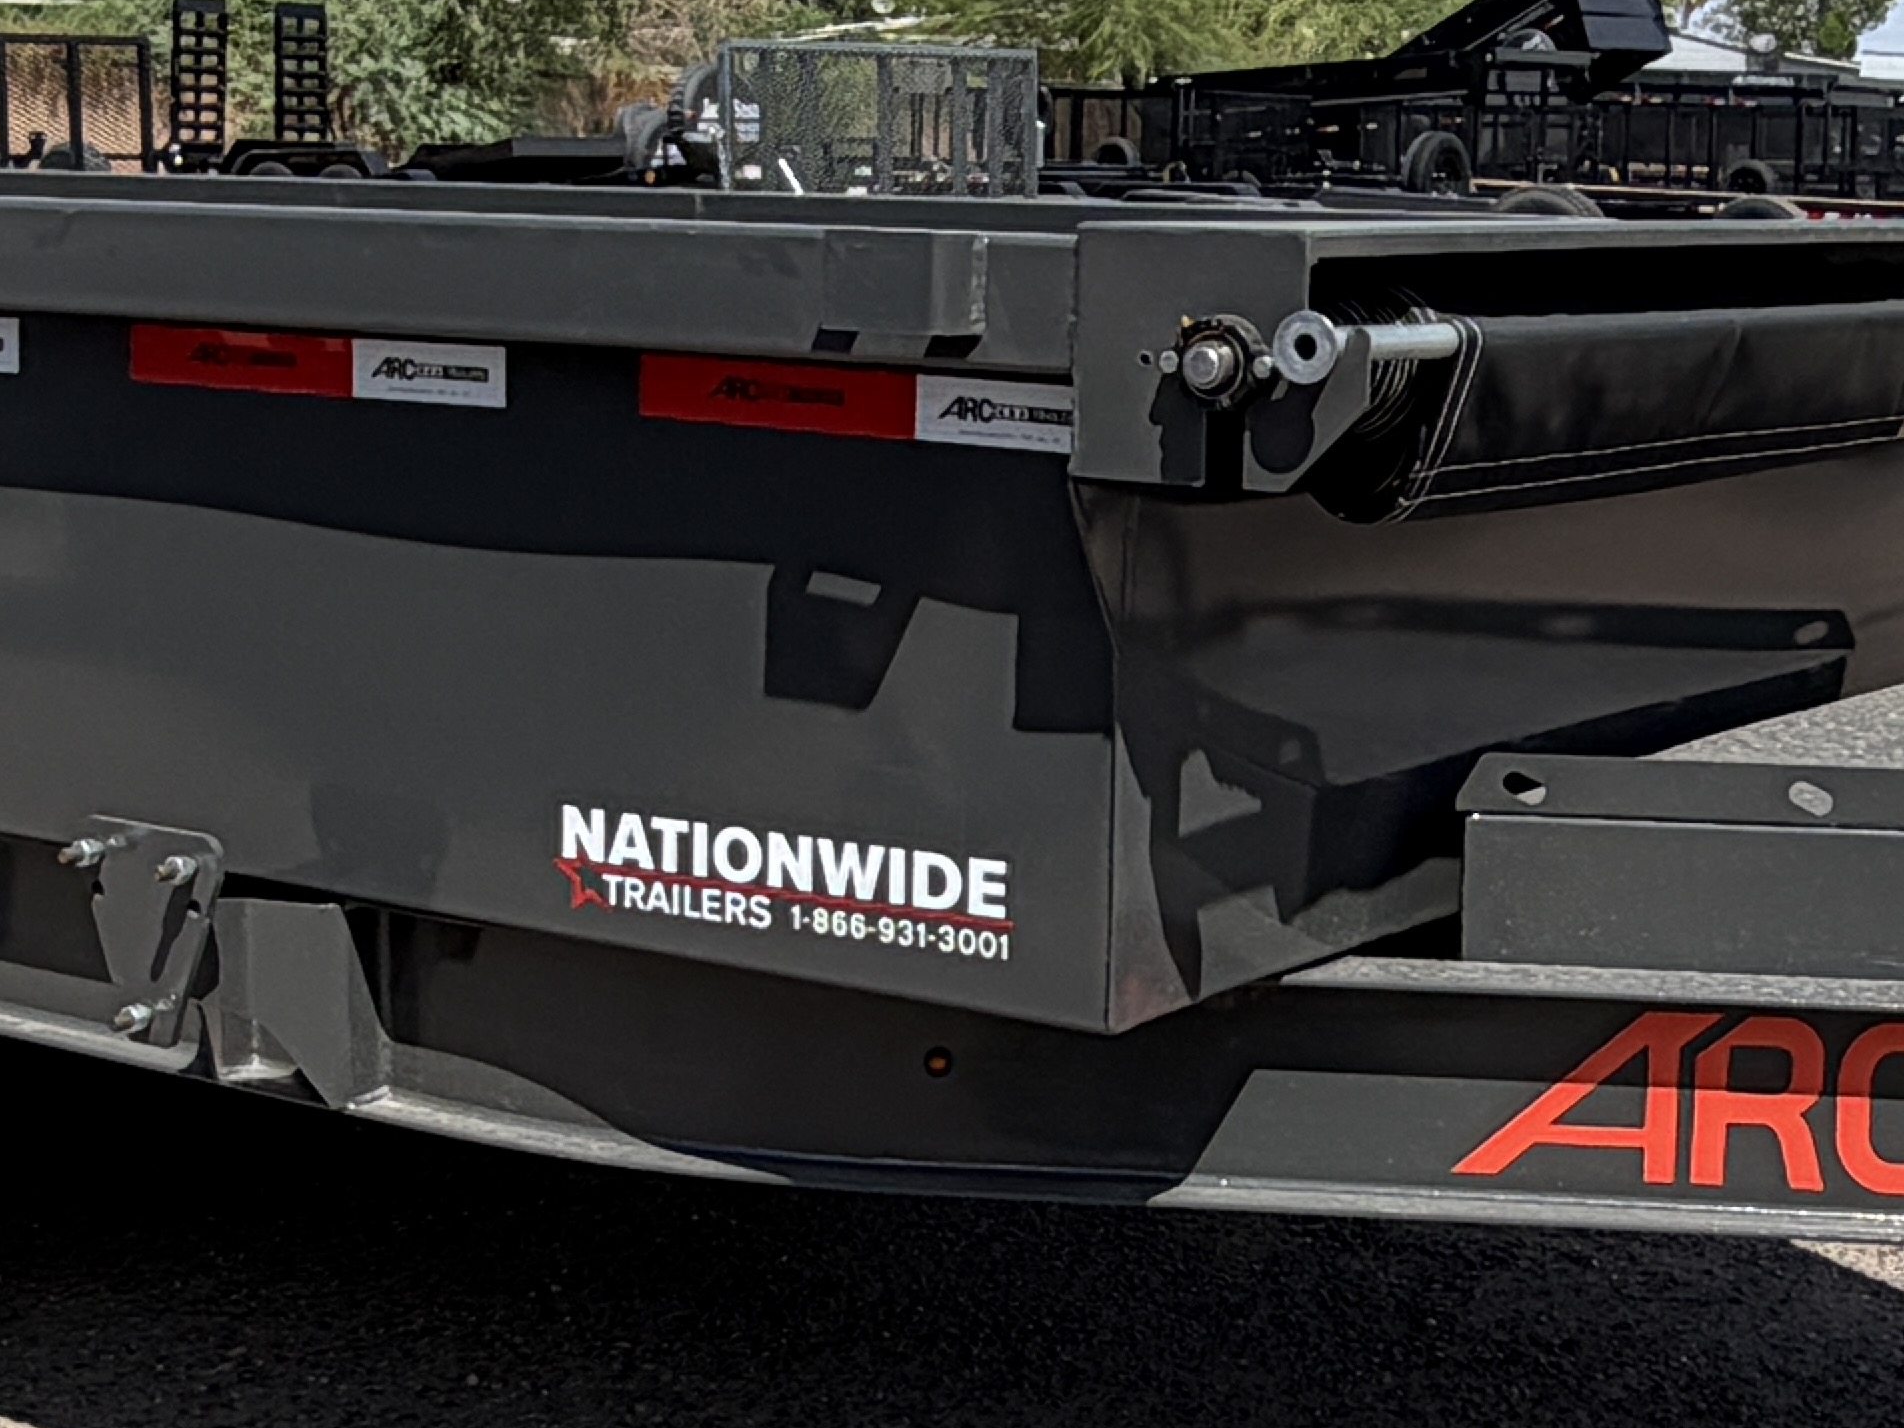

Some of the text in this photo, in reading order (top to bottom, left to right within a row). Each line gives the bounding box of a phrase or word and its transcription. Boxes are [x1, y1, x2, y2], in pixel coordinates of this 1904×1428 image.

[371, 356, 417, 381] ARC
[938, 395, 994, 423] ARC
[561, 804, 1008, 919] NATIONWIDE
[602, 873, 1010, 961] TRAILERS 1-866-931-3001
